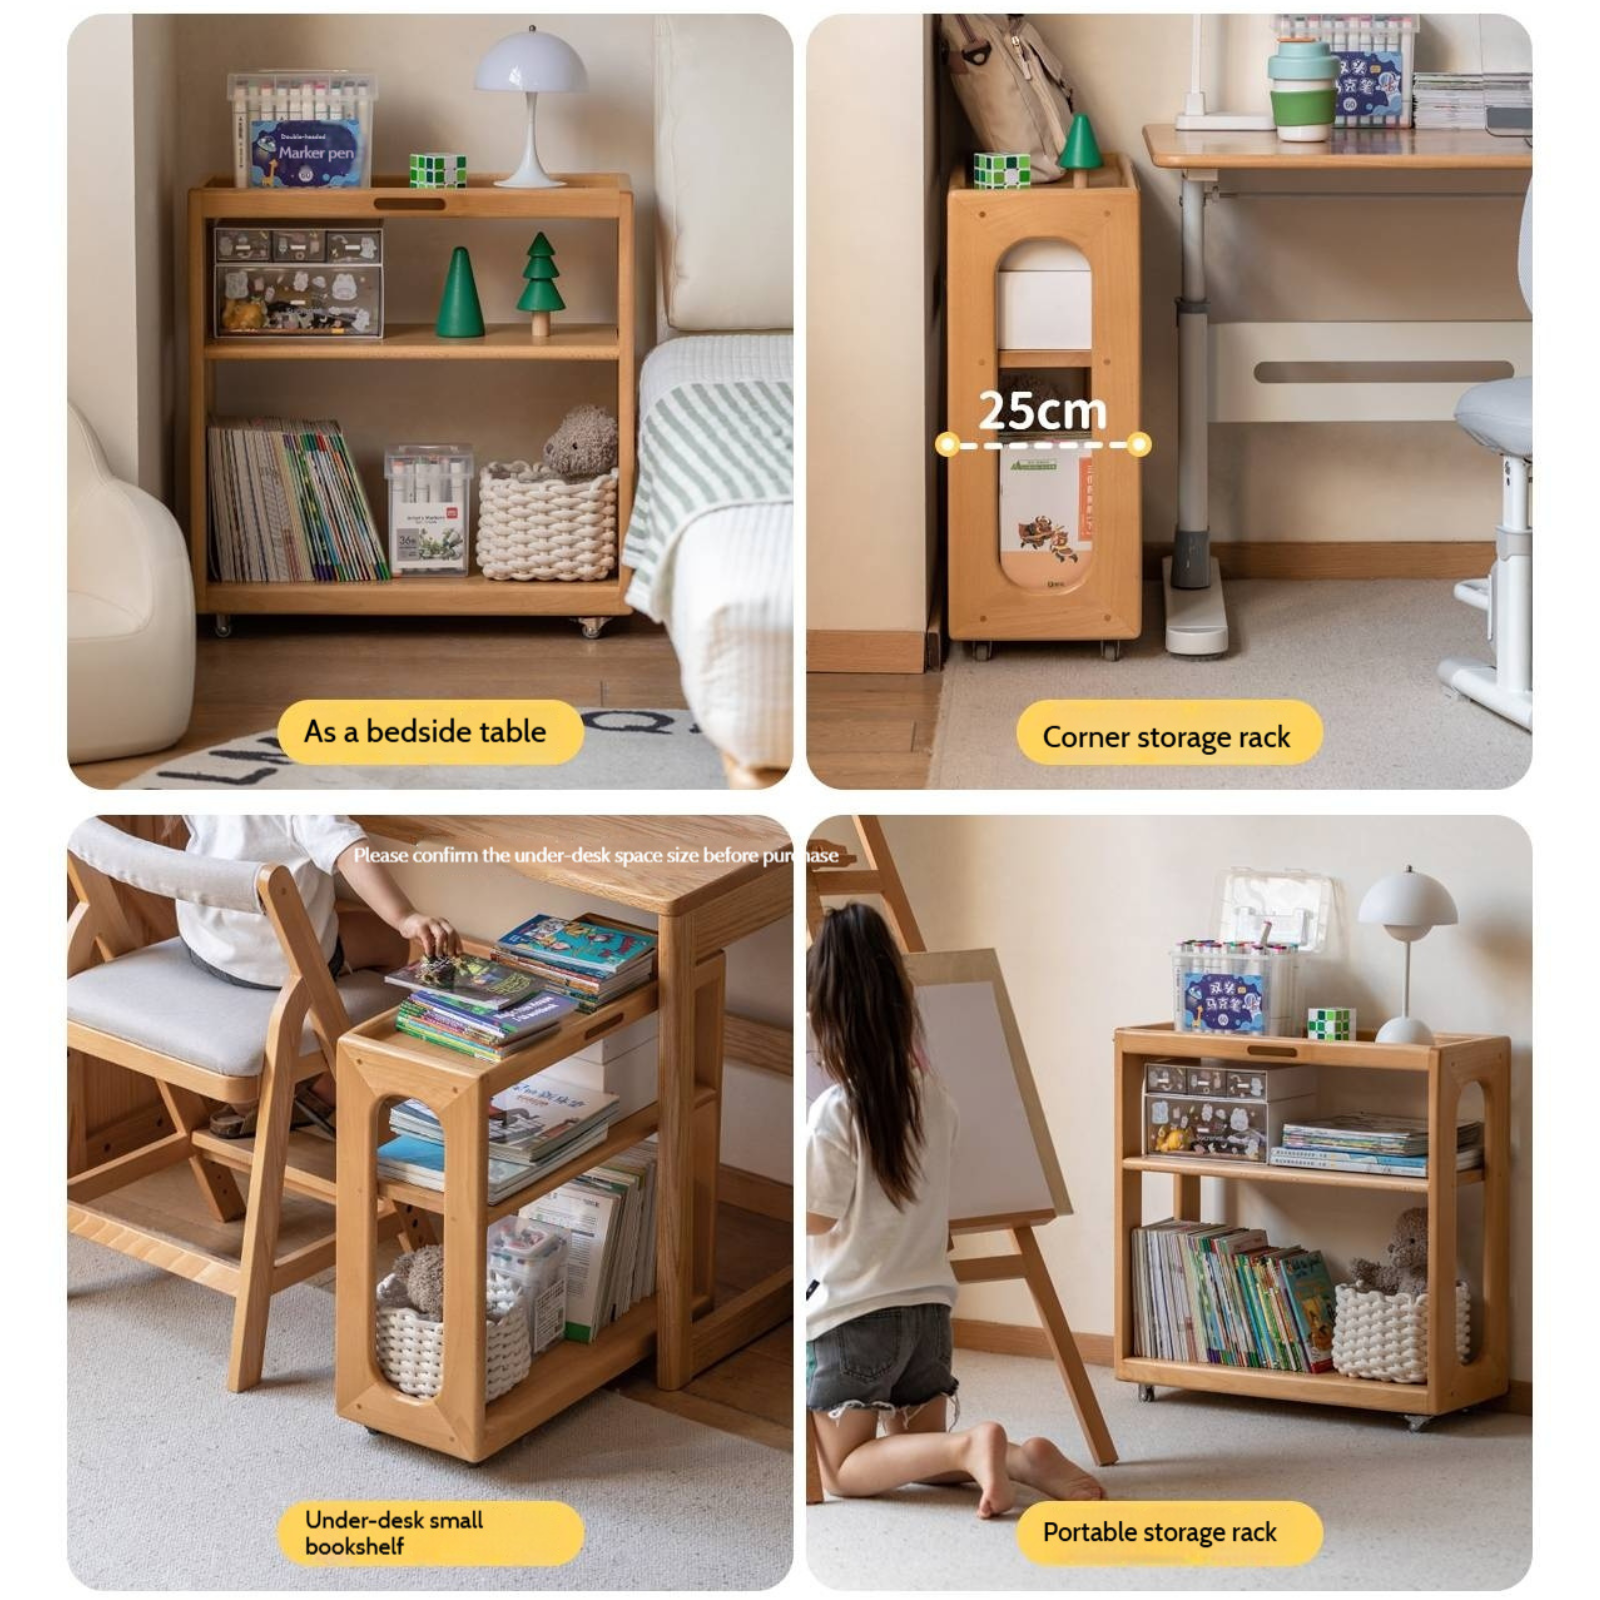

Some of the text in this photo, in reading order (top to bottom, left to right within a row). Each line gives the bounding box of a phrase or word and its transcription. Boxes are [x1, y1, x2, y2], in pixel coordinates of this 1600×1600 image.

[1336, 79, 1374, 95] 克笔
[279, 145, 355, 163] Marker pen
